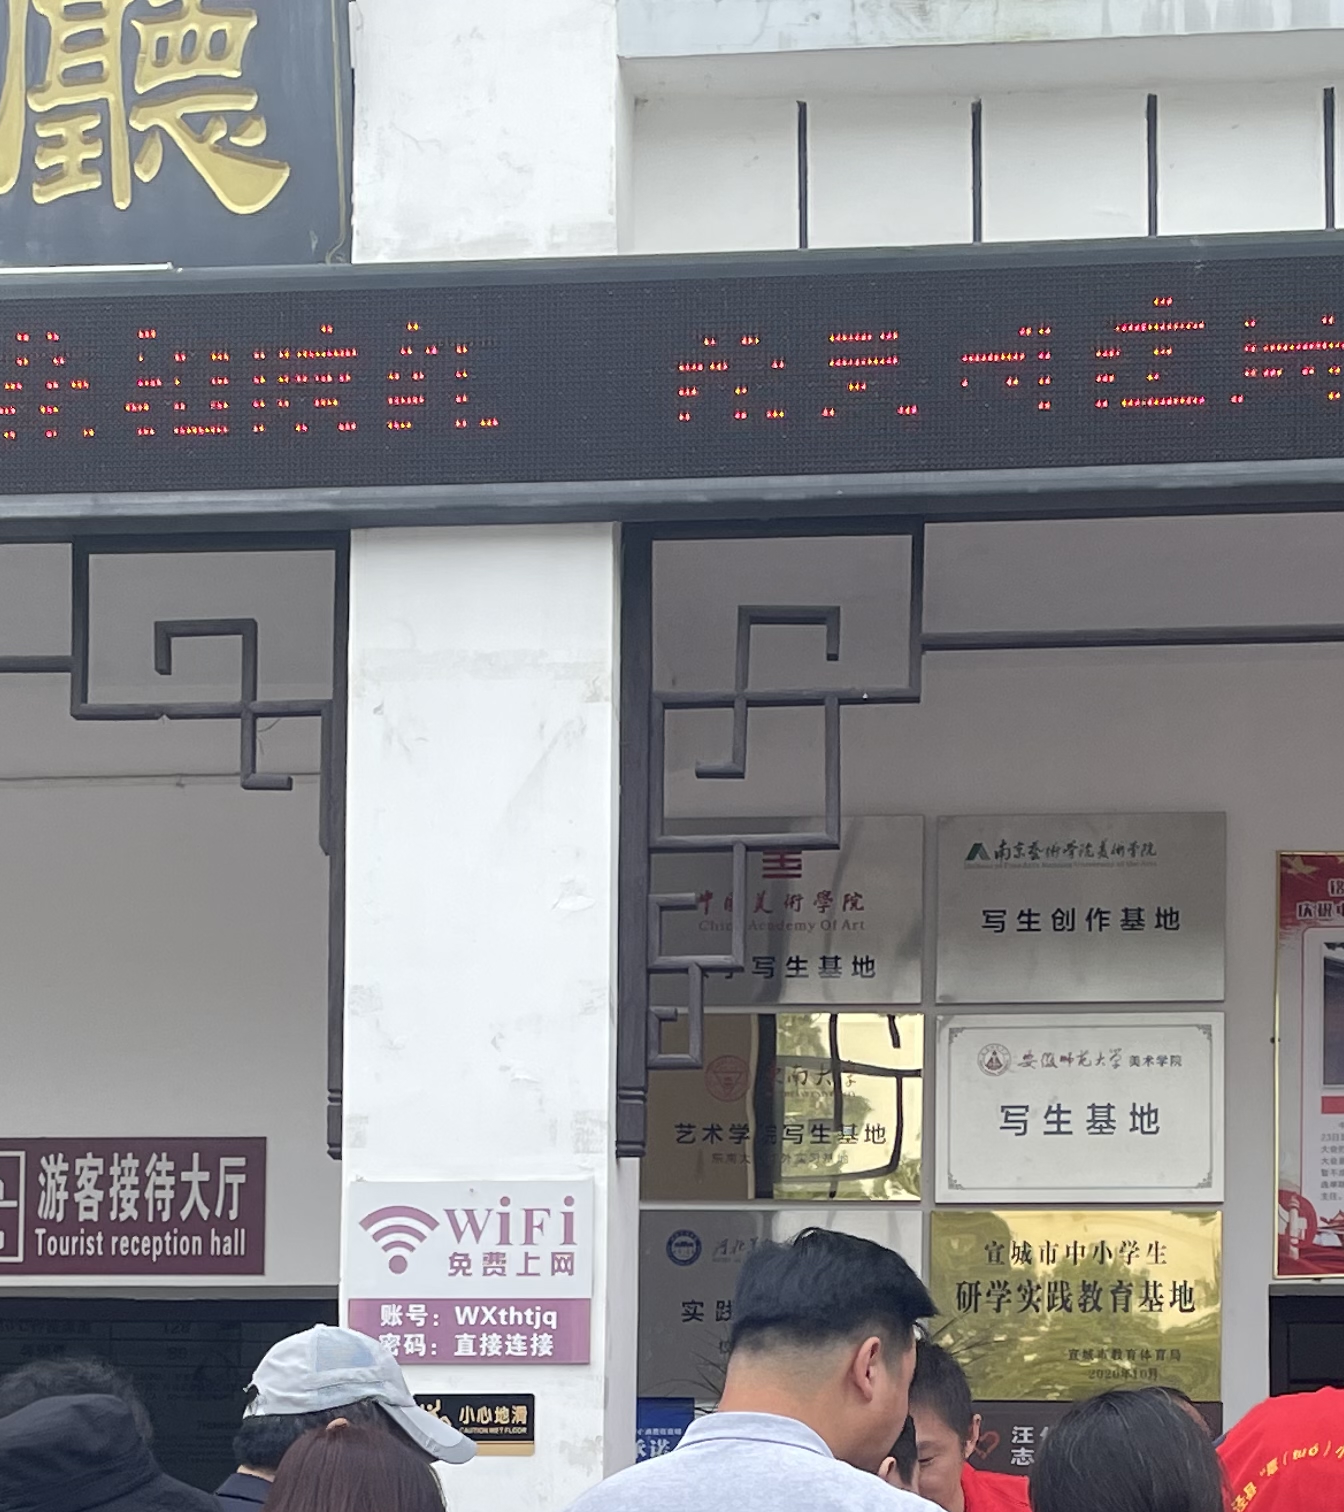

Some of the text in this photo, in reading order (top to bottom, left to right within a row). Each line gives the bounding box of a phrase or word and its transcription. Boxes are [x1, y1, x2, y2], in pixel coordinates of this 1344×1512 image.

[748, 919, 816, 933] Academy
[842, 919, 865, 930] Art
[981, 906, 1182, 934] 写生创作基地
[1129, 1054, 1183, 1068] 美术学院
[999, 1103, 1160, 1137] 写生基地
[36, 1151, 247, 1222] 游客接待大厅
[443, 1195, 578, 1246] WiFi
[35, 1228, 247, 1262] Tourist reception hall
[984, 1239, 1169, 1267] 宣城市中小学生
[448, 1251, 575, 1277] 免费上网
[956, 1278, 1197, 1315] 研学实践教育基地
[454, 1304, 558, 1329] WXthtjq
[453, 1333, 554, 1357] 直接连接
[1067, 1347, 1183, 1363] 宣城市教育体育局
[1087, 1366, 1160, 1382] 2020年10月
[458, 1405, 528, 1426] 小心地滑
